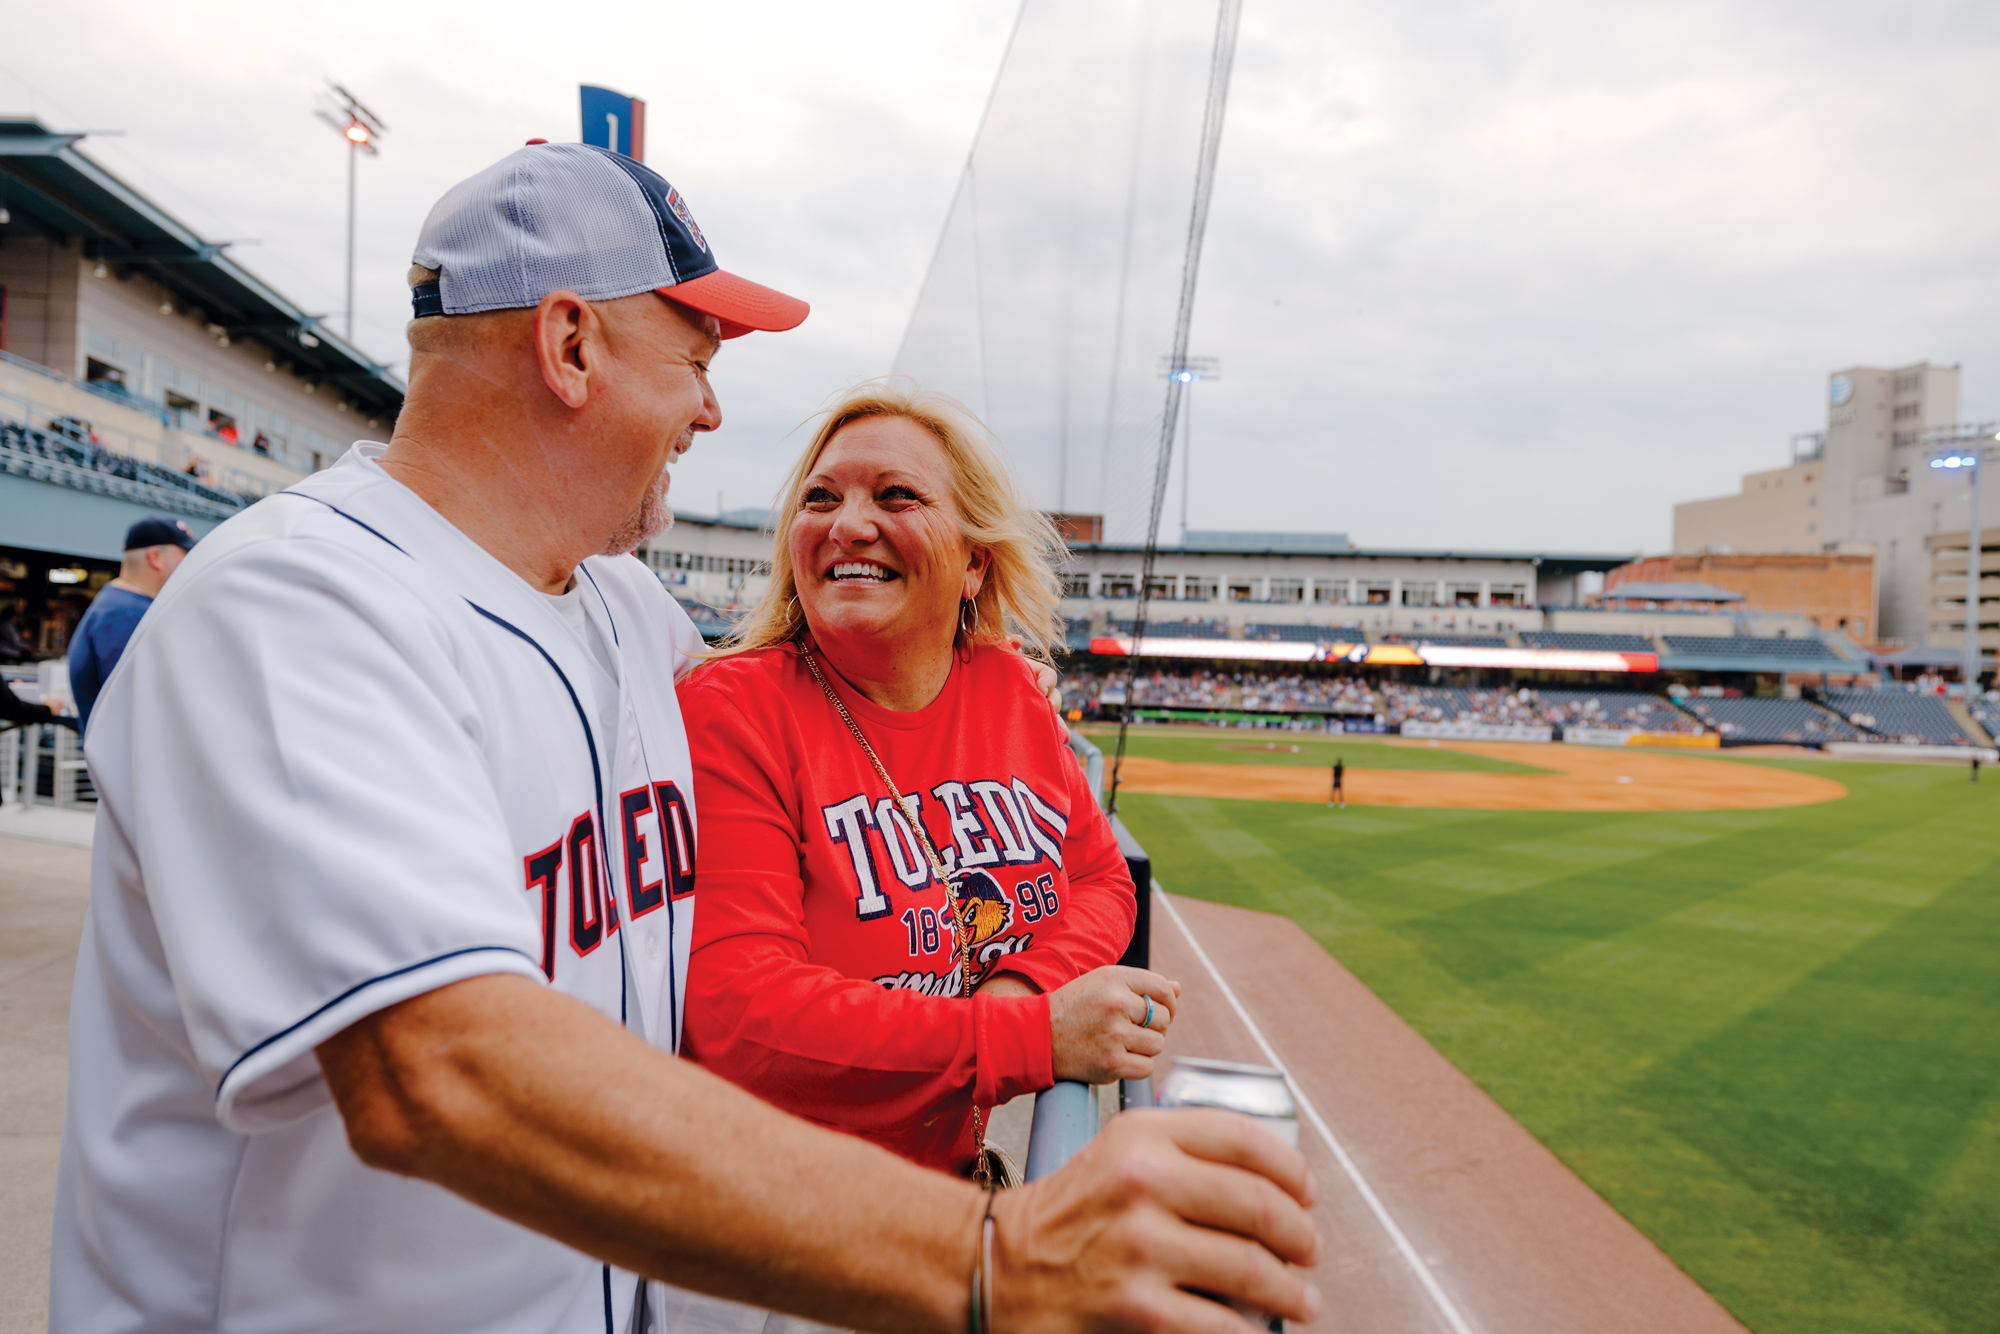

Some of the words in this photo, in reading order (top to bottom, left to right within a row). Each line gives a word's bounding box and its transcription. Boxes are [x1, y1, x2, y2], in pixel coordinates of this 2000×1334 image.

[821, 775, 1068, 922] TOLEDO
[900, 907, 940, 956] 18
[1015, 872, 1060, 923] 96
